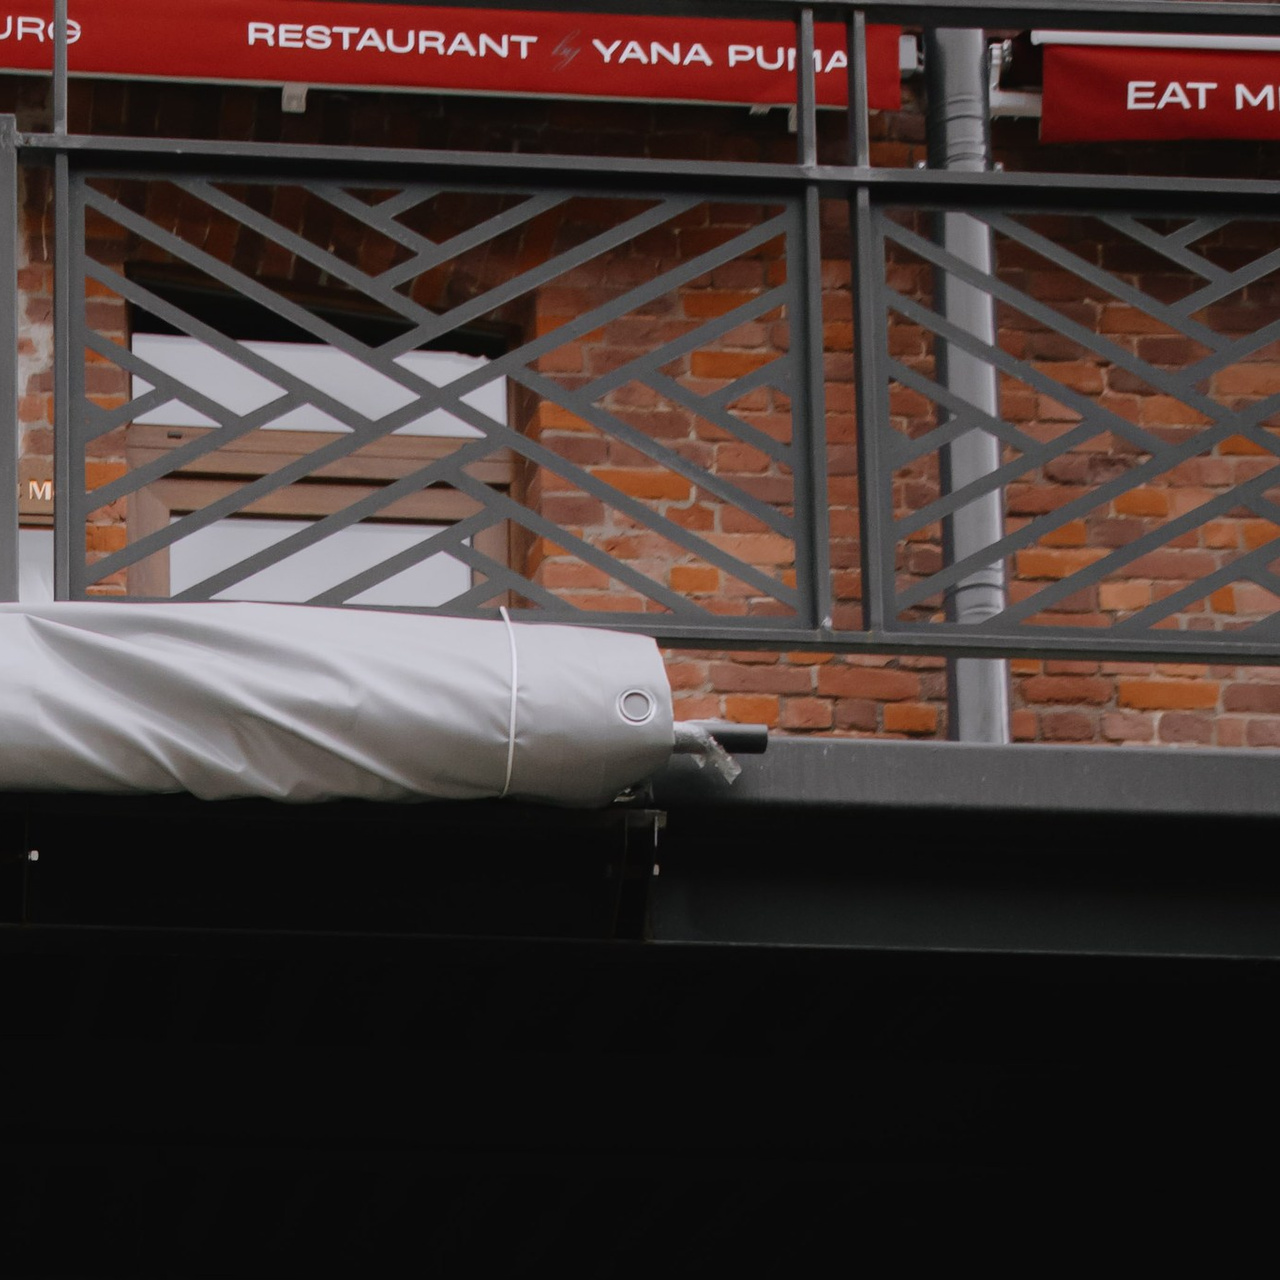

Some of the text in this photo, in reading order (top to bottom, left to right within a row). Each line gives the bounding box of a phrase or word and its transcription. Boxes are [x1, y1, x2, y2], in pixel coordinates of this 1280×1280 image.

[248, 22, 538, 60] RESTAURANT
[592, 38, 713, 67] YANA
[1126, 80, 1280, 112] EAT M
